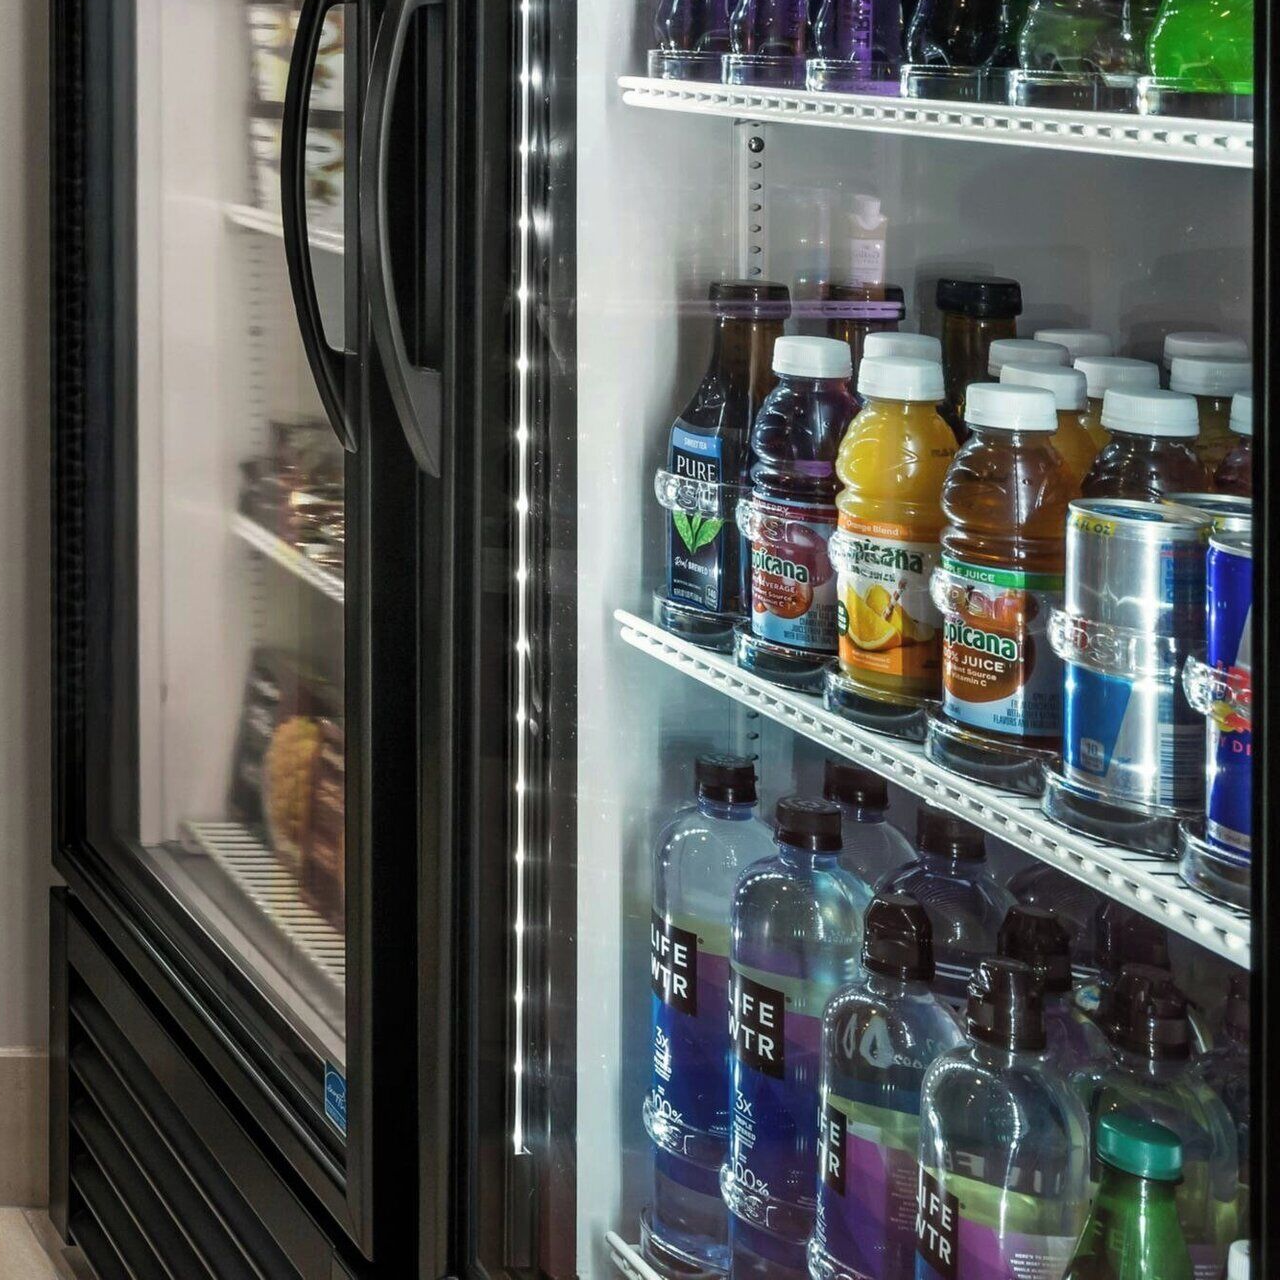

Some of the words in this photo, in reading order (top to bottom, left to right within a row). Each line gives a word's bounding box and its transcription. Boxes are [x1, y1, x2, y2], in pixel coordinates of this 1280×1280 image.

[676, 455, 716, 482] PURE
[846, 520, 872, 532] Orange
[872, 524, 899, 536] Blend
[752, 547, 809, 584] picana
[965, 570, 996, 583] JUICE
[944, 619, 1018, 661] picana
[962, 654, 1004, 673] JUICE
[966, 668, 997, 681] Source
[980, 679, 987, 687] C
[651, 922, 688, 968] LIFE
[651, 959, 688, 999] WTR
[728, 979, 775, 1029] LIFE
[655, 1025, 669, 1048] 3X
[728, 1011, 775, 1061] WTR
[735, 1090, 752, 1117] 3X
